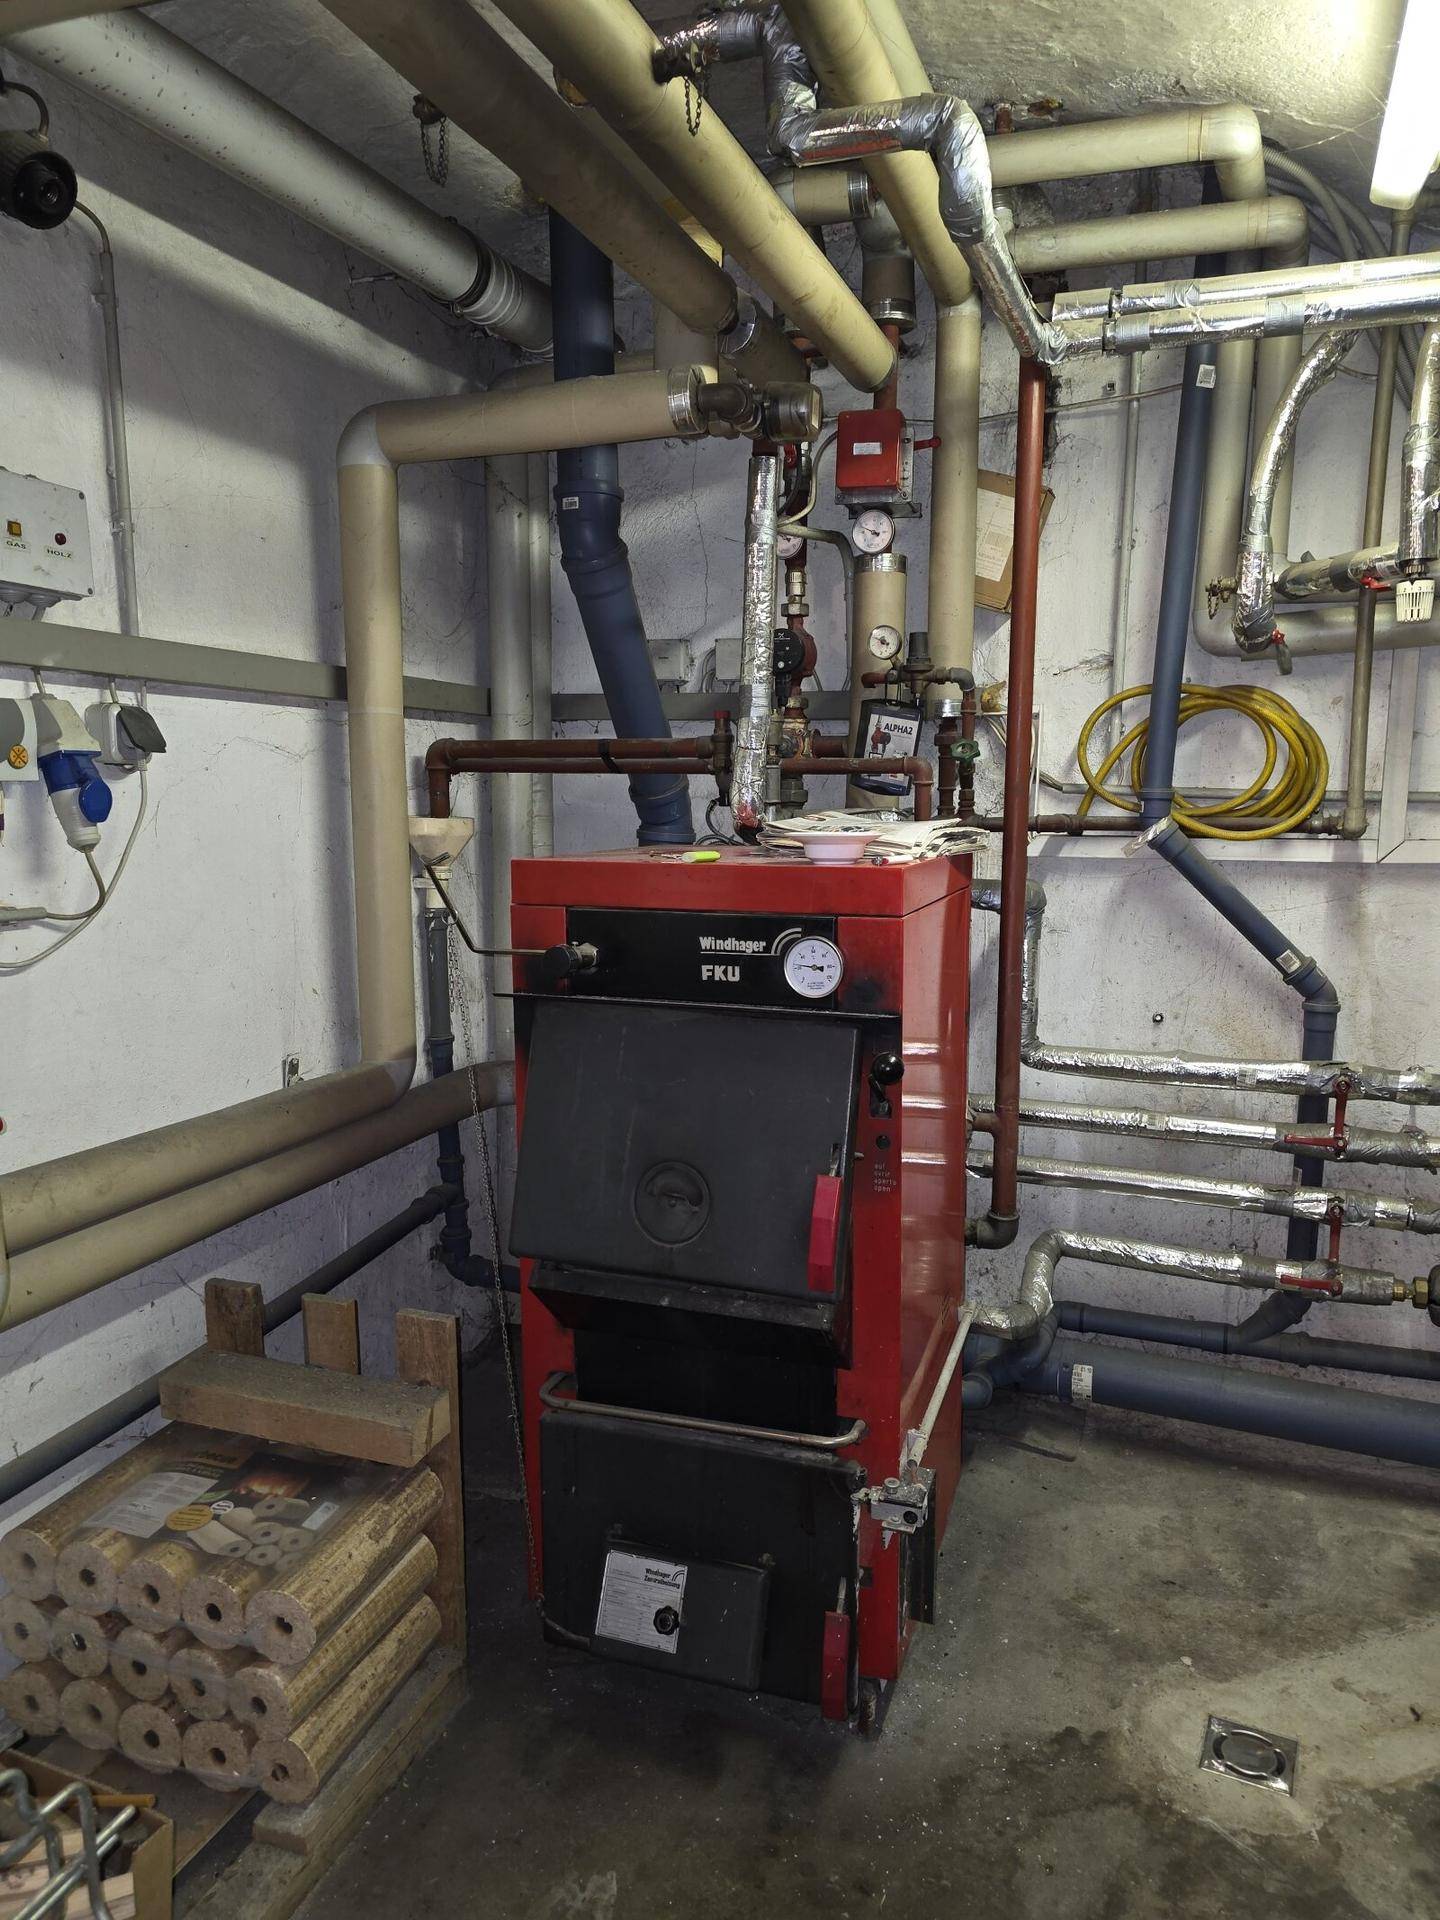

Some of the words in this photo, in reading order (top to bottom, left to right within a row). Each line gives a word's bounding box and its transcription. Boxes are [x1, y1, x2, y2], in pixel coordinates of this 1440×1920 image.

[6, 540, 27, 550] GAS
[47, 548, 73, 559] HOLZ
[883, 722, 913, 736] ALPHA2
[699, 936, 767, 954] Windhager
[701, 964, 741, 982] FKU
[873, 1185, 891, 1193] open
